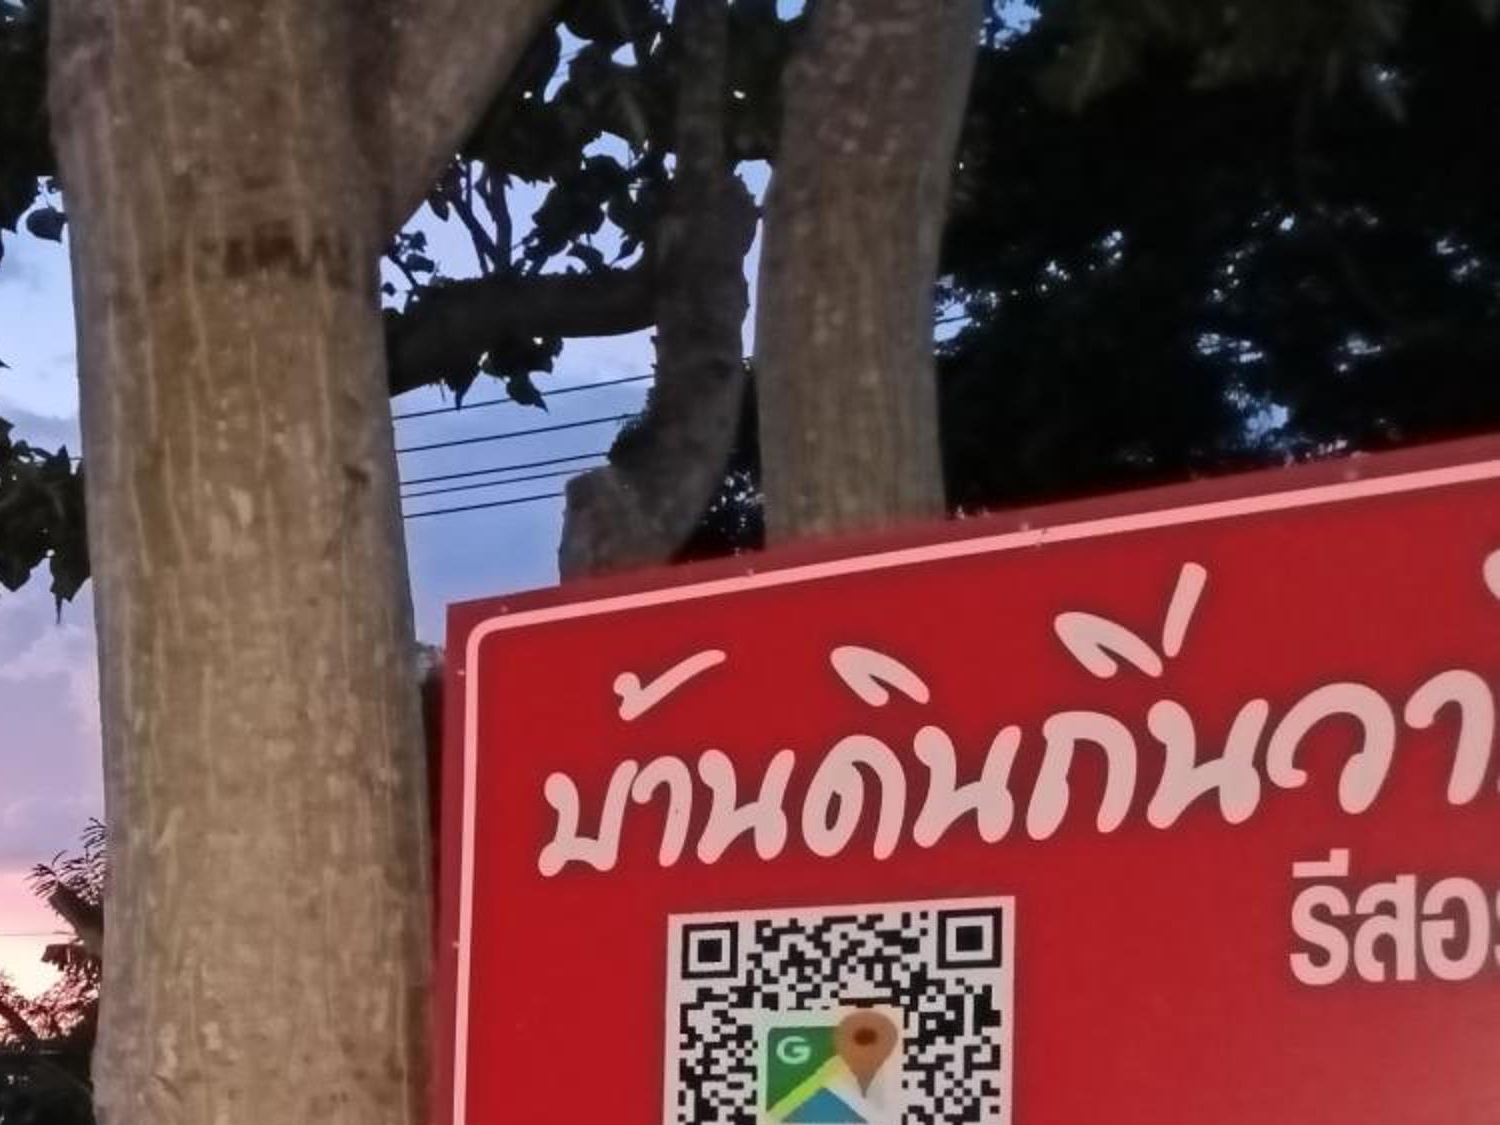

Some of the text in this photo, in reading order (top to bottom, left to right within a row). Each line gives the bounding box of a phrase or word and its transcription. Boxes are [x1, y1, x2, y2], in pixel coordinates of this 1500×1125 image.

[538, 549, 1500, 877] บ้านดินถิ่นวา
[1289, 848, 1500, 985] รีสอ
[776, 1035, 813, 1065] G
